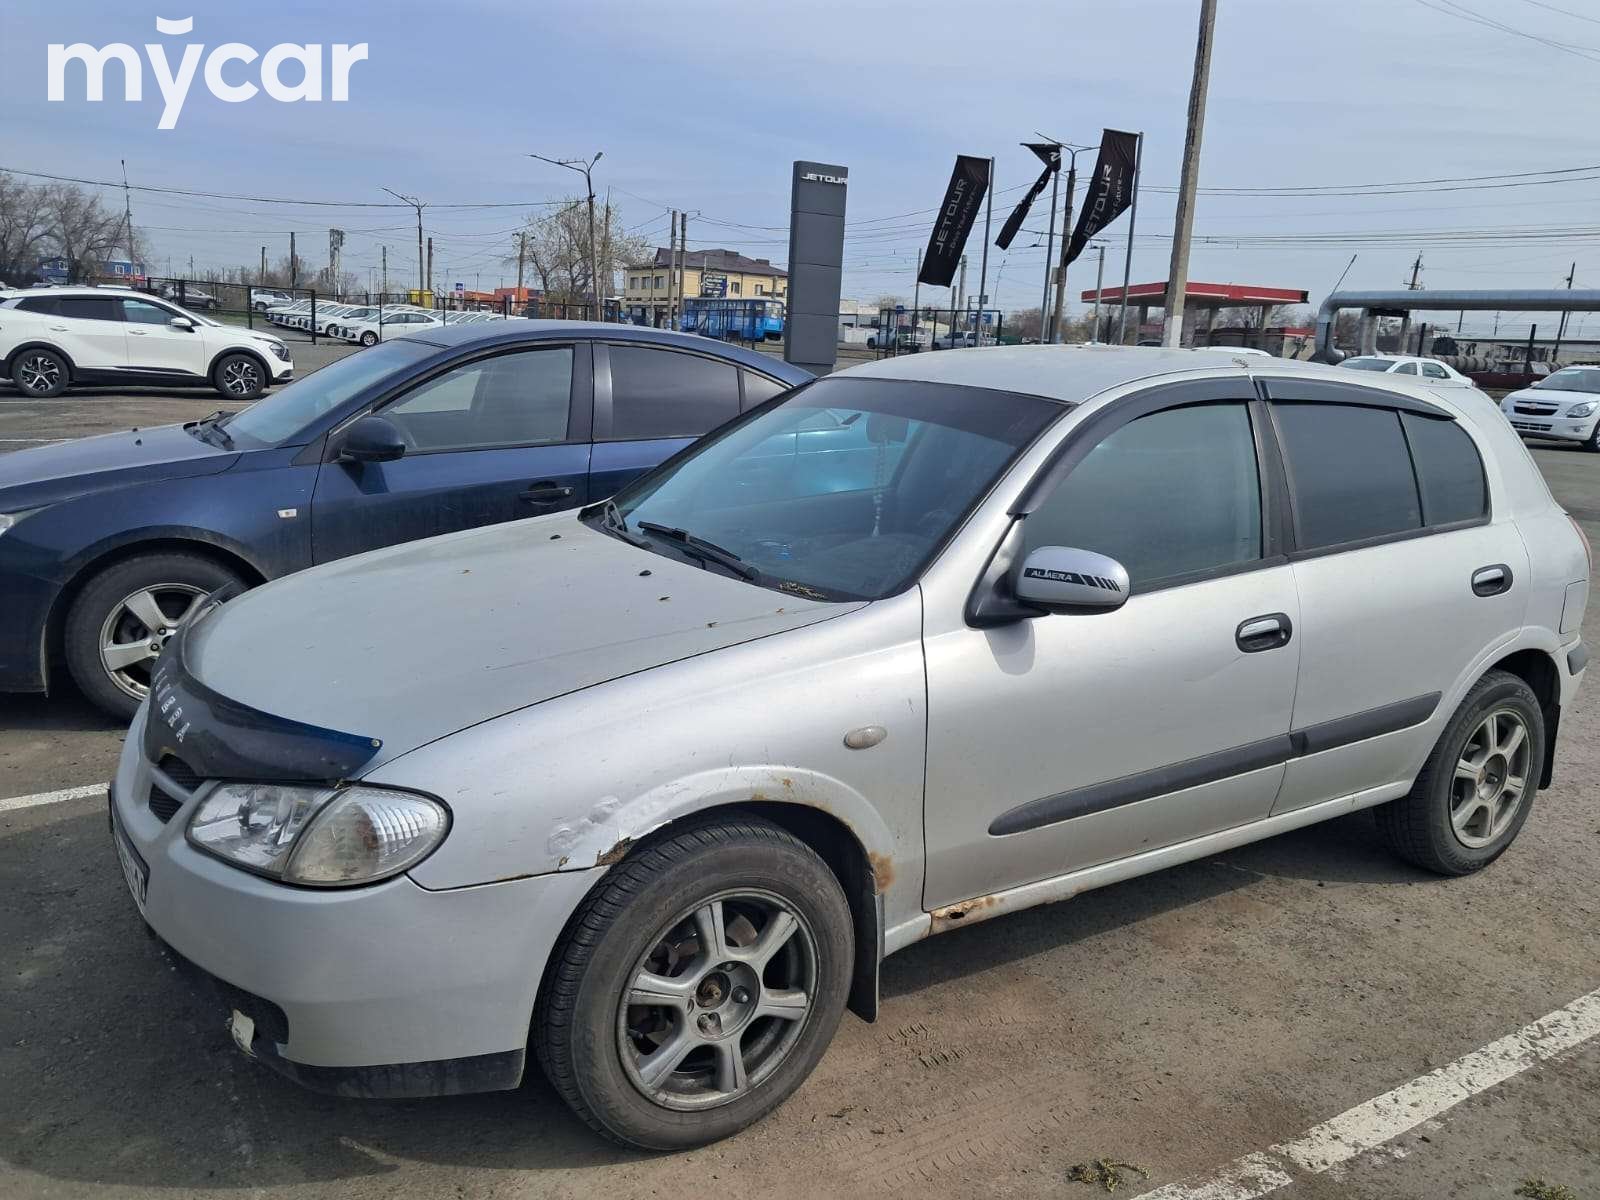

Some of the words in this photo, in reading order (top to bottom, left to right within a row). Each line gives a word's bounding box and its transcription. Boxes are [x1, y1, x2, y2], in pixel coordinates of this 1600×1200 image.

[801, 173, 848, 185] JETOUR
[935, 179, 968, 255] JETOUR
[1031, 568, 1073, 582] ALMERA
